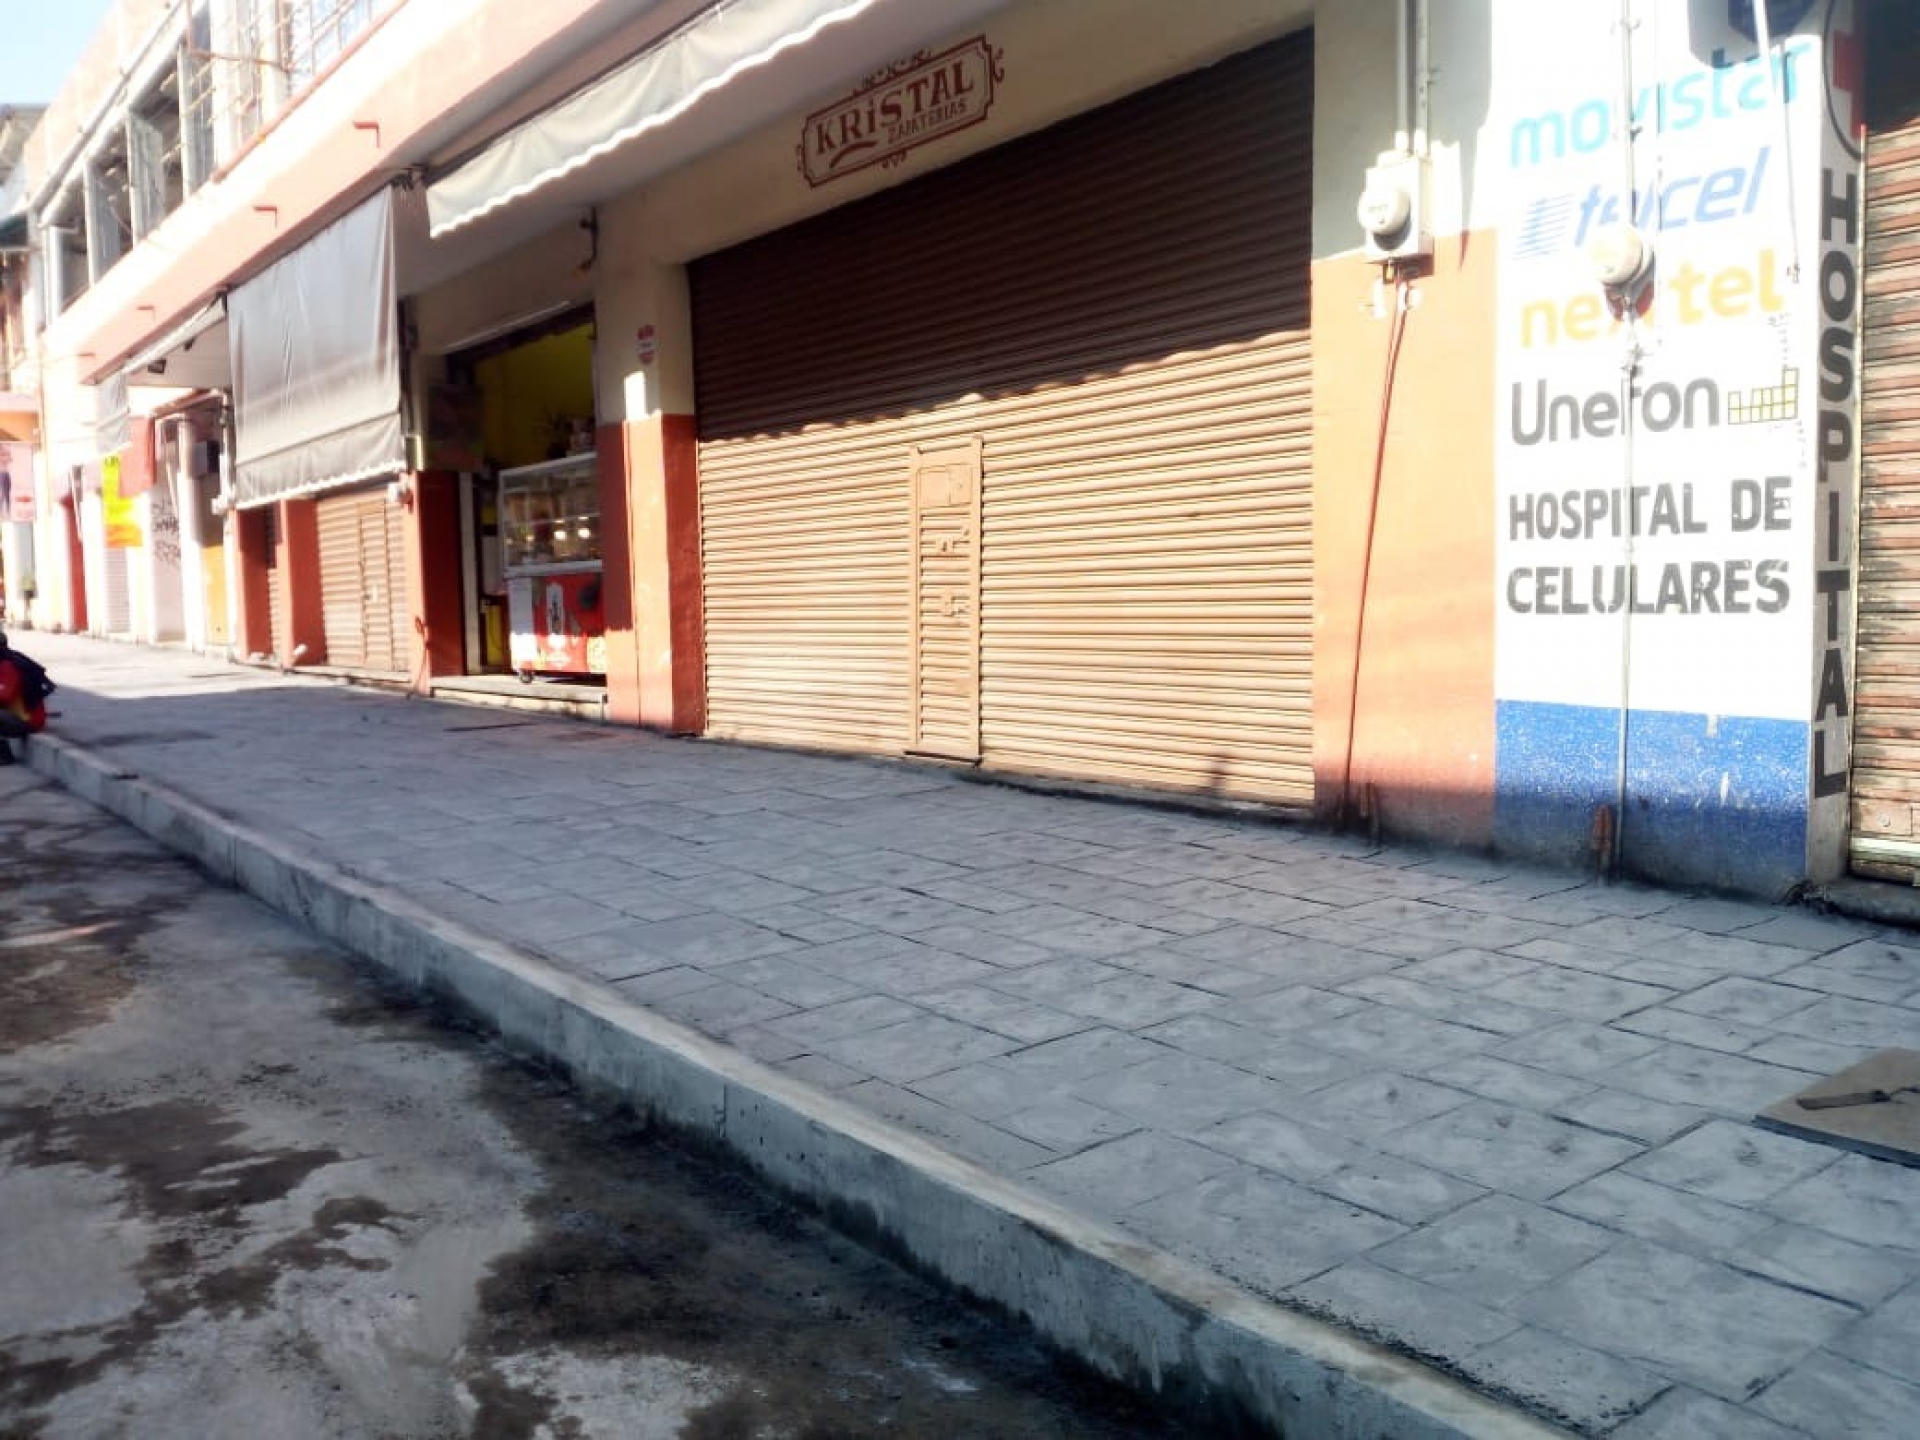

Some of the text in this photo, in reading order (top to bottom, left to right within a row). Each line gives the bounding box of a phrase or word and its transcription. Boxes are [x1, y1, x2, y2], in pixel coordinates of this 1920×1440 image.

[1509, 42, 1812, 169] movistar
[1508, 476, 1792, 541] HOSPITAL DE
[1813, 167, 1857, 799] HOSPITAL
[1506, 558, 1791, 616] CELULARES
